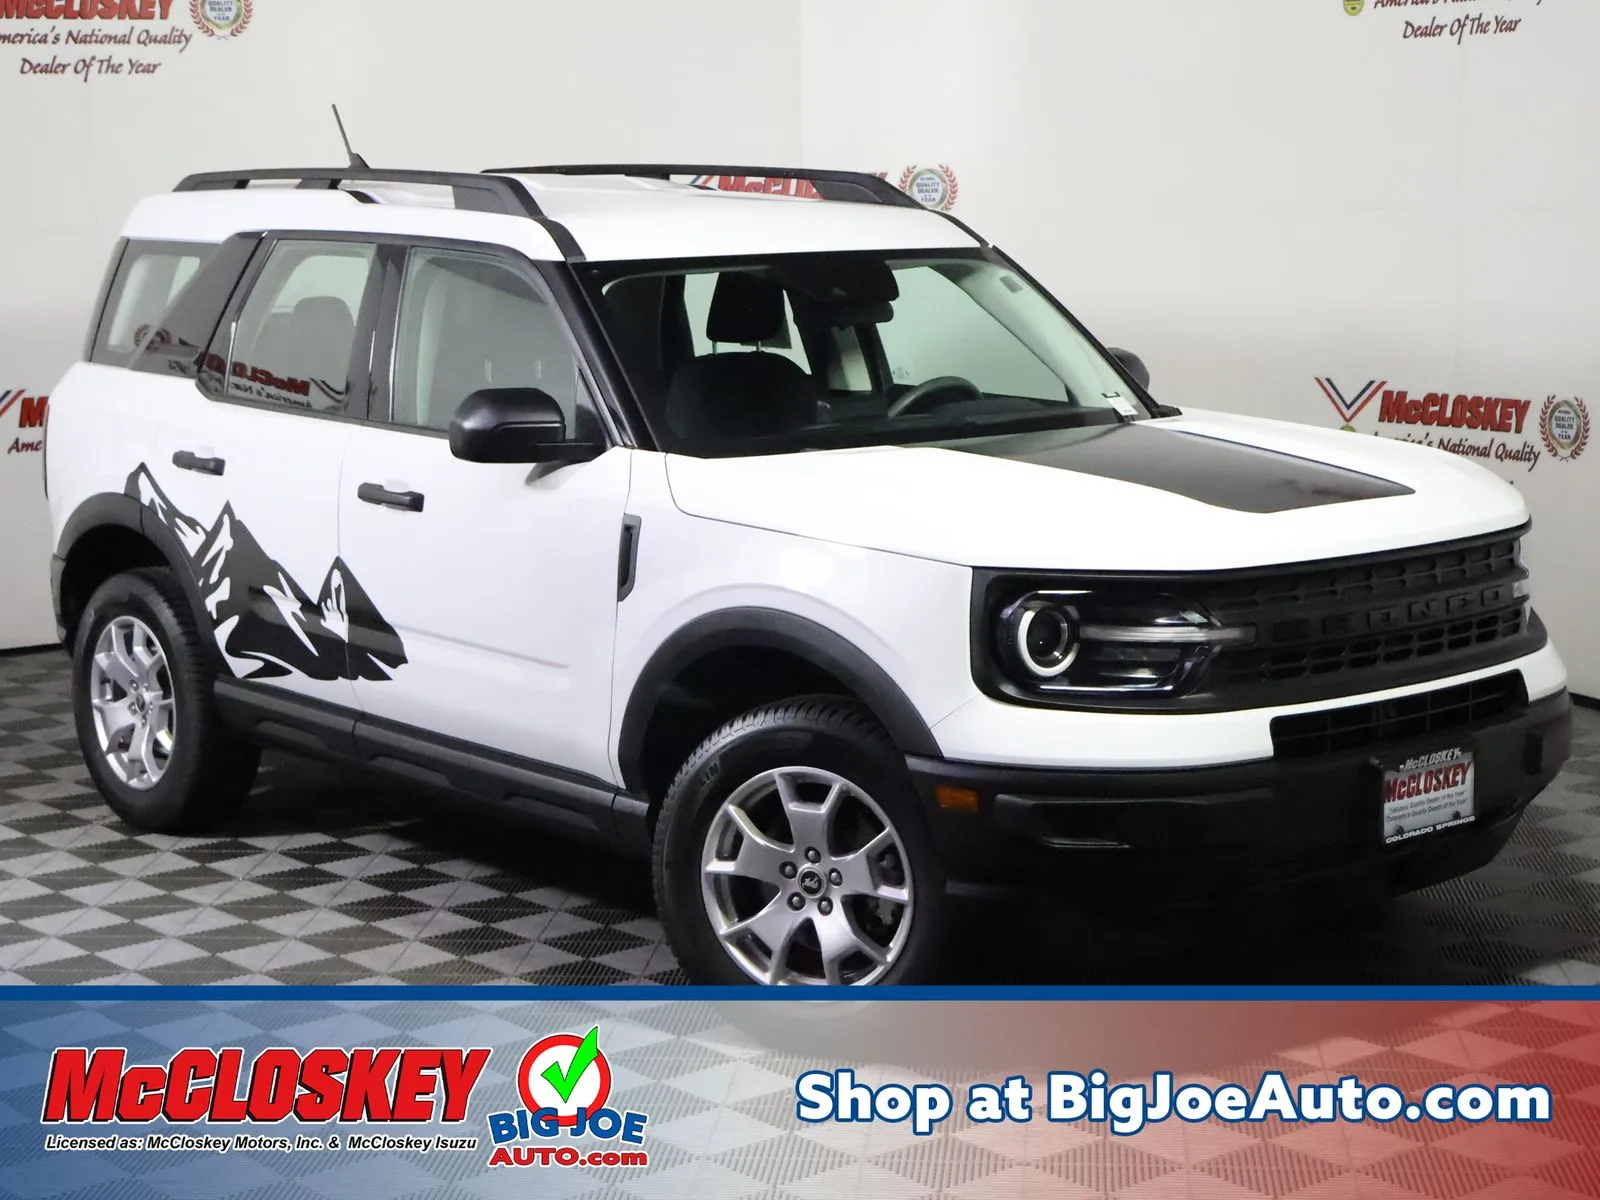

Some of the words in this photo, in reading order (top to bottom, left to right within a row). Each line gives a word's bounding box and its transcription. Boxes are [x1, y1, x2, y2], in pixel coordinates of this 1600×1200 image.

[0, 26, 61, 45] merica's
[65, 26, 134, 45] National
[136, 25, 192, 52] Quality
[1402, 16, 1448, 39] Dealer
[1449, 13, 1469, 46] Of
[1470, 13, 1491, 35] The
[1493, 15, 1522, 34] Year
[20, 56, 71, 75] Dealer
[73, 55, 96, 83] Of
[97, 56, 123, 74] The
[127, 58, 162, 75] Year
[1378, 390, 1531, 434] McCLOSKEY
[1437, 438, 1494, 458] National
[1495, 441, 1540, 472] Quality
[1404, 748, 1461, 771] McCLOSKEY
[1384, 760, 1472, 804] McCLOSKEY
[1386, 826, 1434, 844] COLORADO
[1435, 815, 1475, 831] SPRINGS
